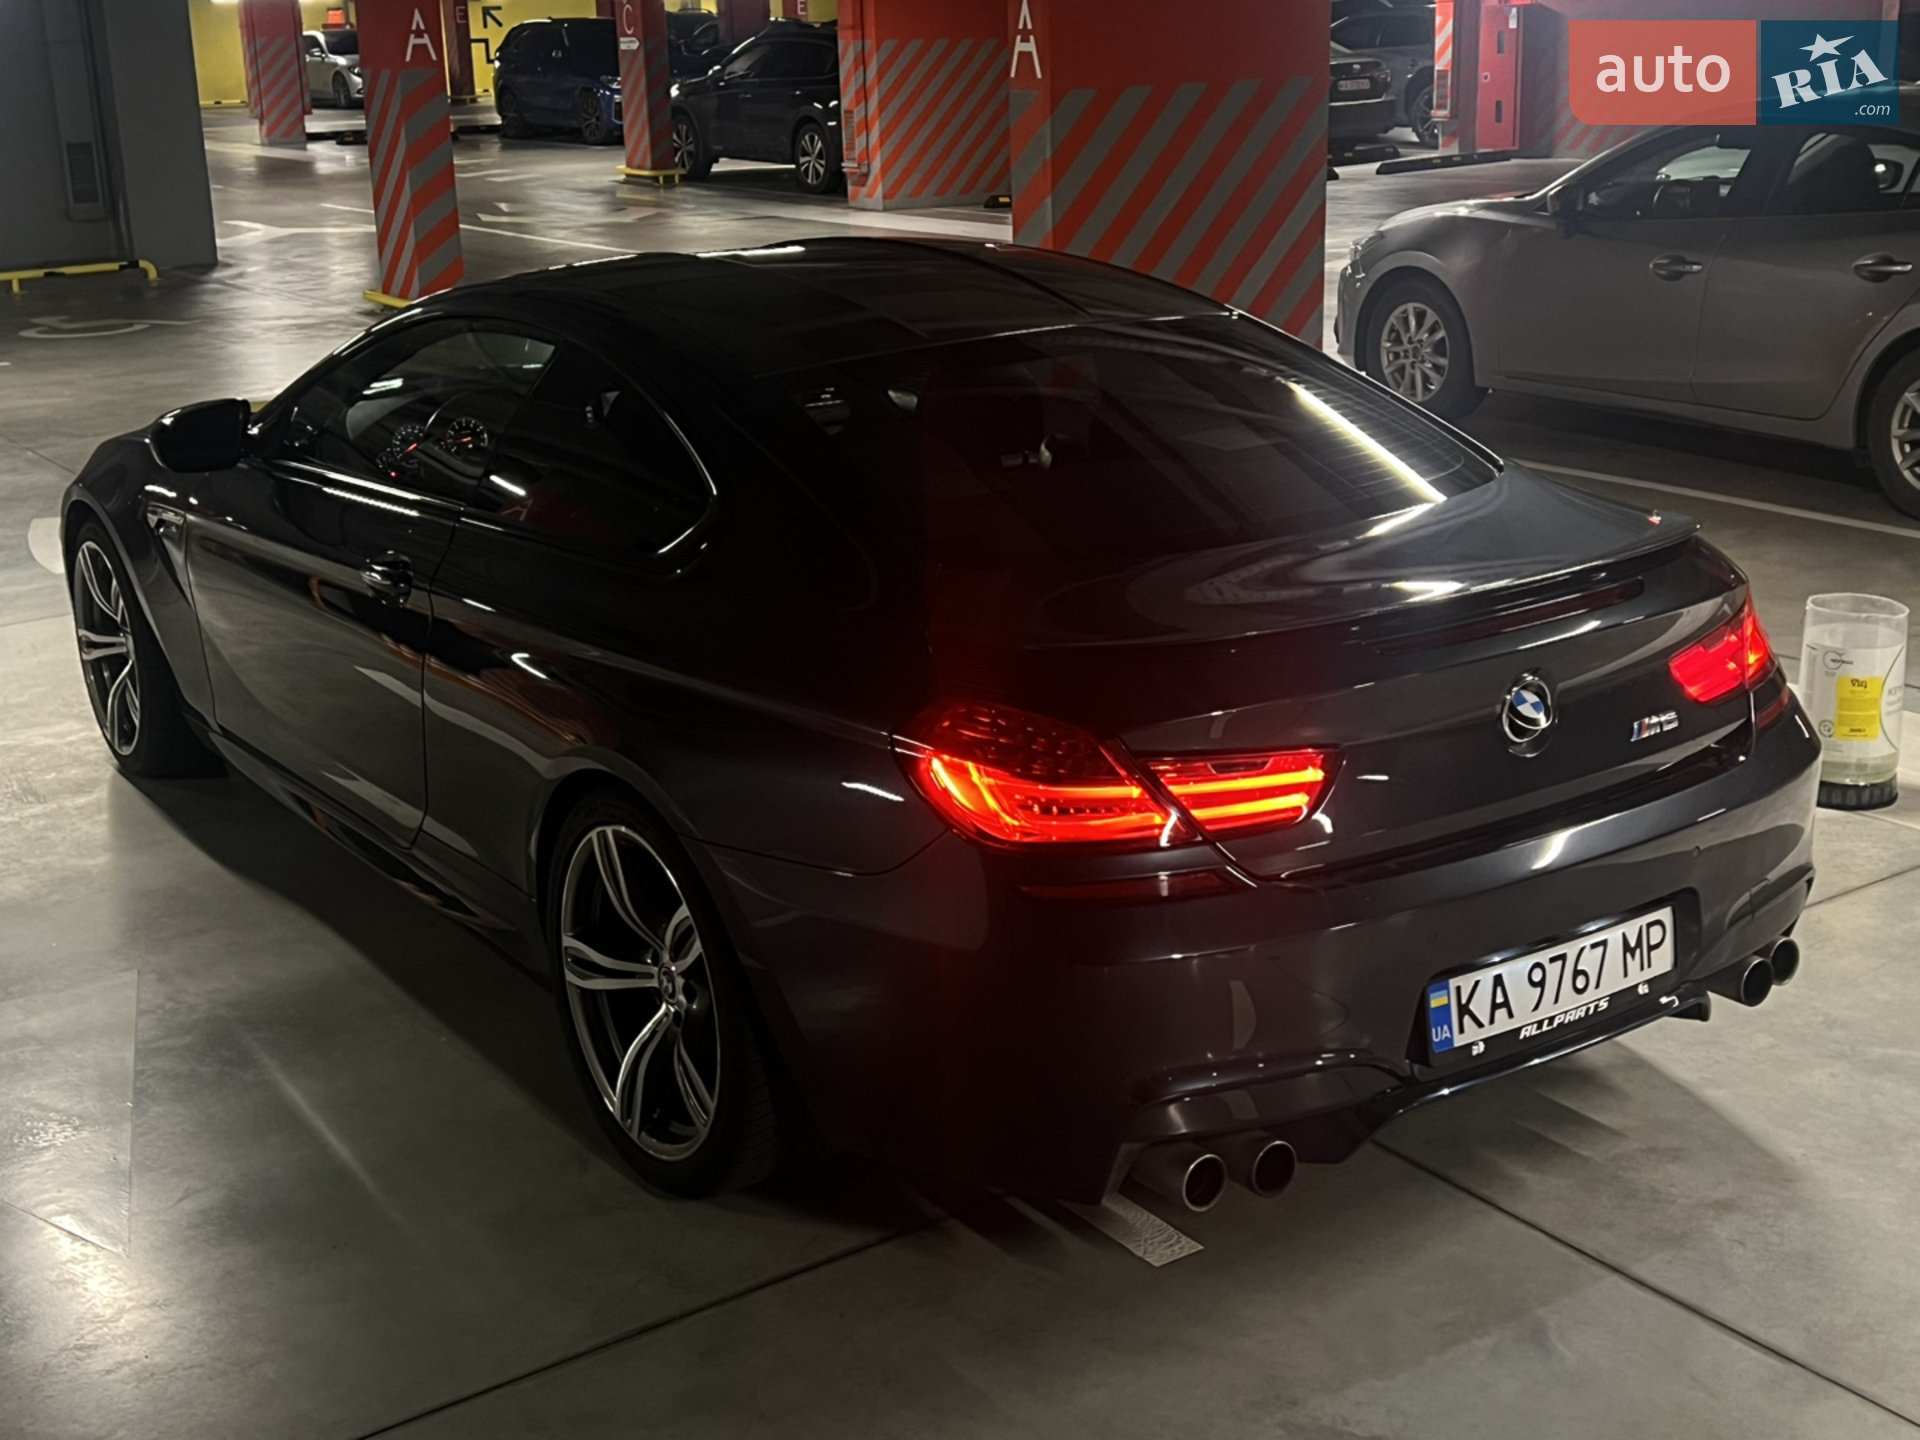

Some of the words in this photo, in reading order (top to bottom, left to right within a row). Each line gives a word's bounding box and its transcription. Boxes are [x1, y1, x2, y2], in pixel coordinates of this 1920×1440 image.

[405, 8, 437, 62] A
[455, 6, 467, 24] E
[622, 4, 635, 35] C
[1010, 0, 1042, 79] A
[1454, 972, 1515, 1036] KA
[1527, 938, 1609, 1013] 9767
[1621, 918, 1667, 978] MP
[1431, 1024, 1452, 1042] UA
[1518, 996, 1611, 1040] ALLPARTS
